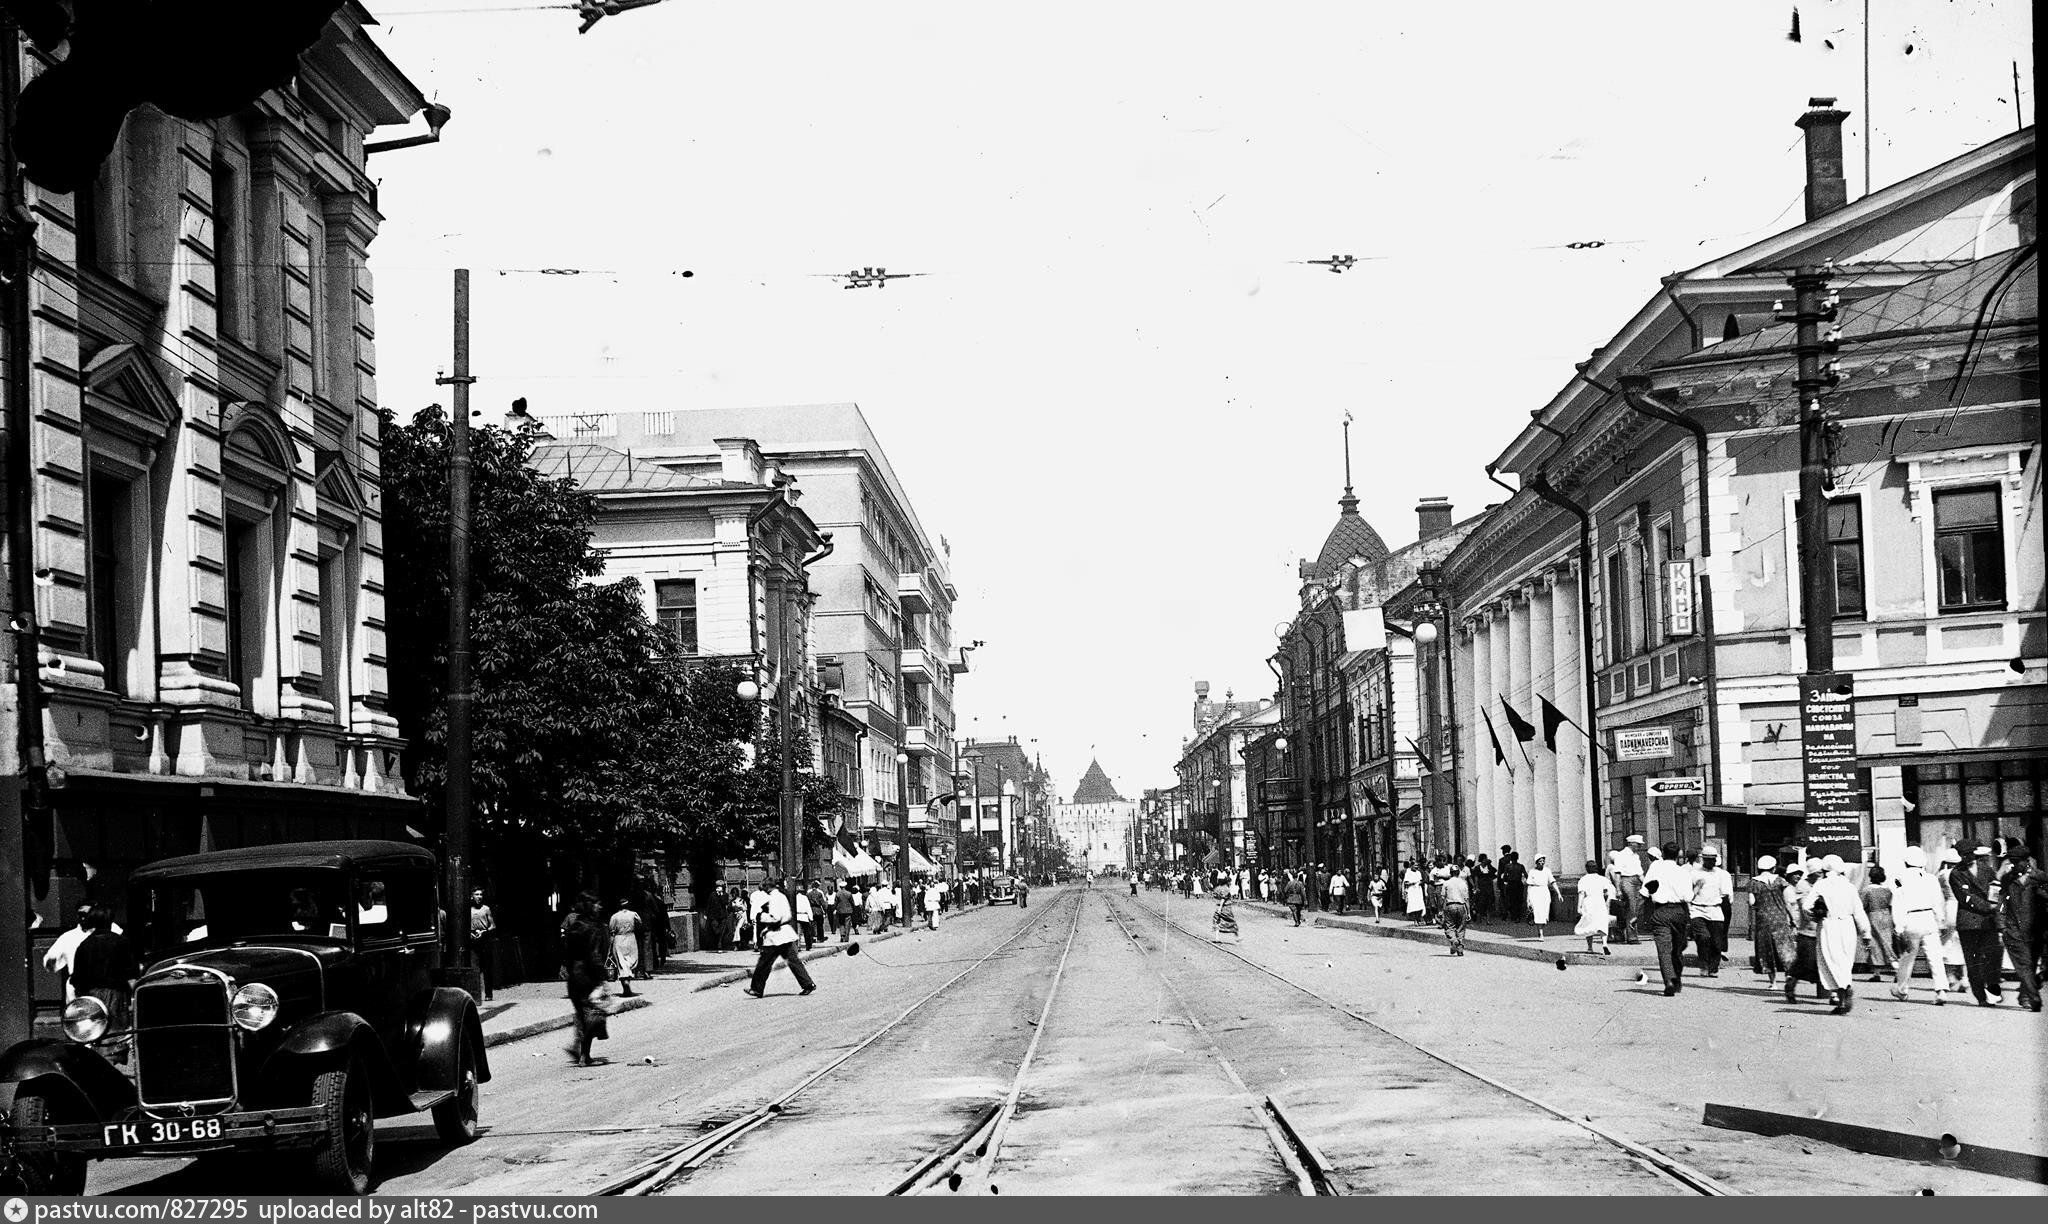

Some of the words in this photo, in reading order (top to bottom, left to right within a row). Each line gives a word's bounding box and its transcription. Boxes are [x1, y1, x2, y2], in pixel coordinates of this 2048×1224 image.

[1673, 564, 1689, 630] КИНО
[1811, 714, 1843, 722] СОЮЗА
[1823, 733, 1835, 741] НА
[104, 1124, 140, 1146] ГК
[151, 1118, 221, 1142] 30-68
